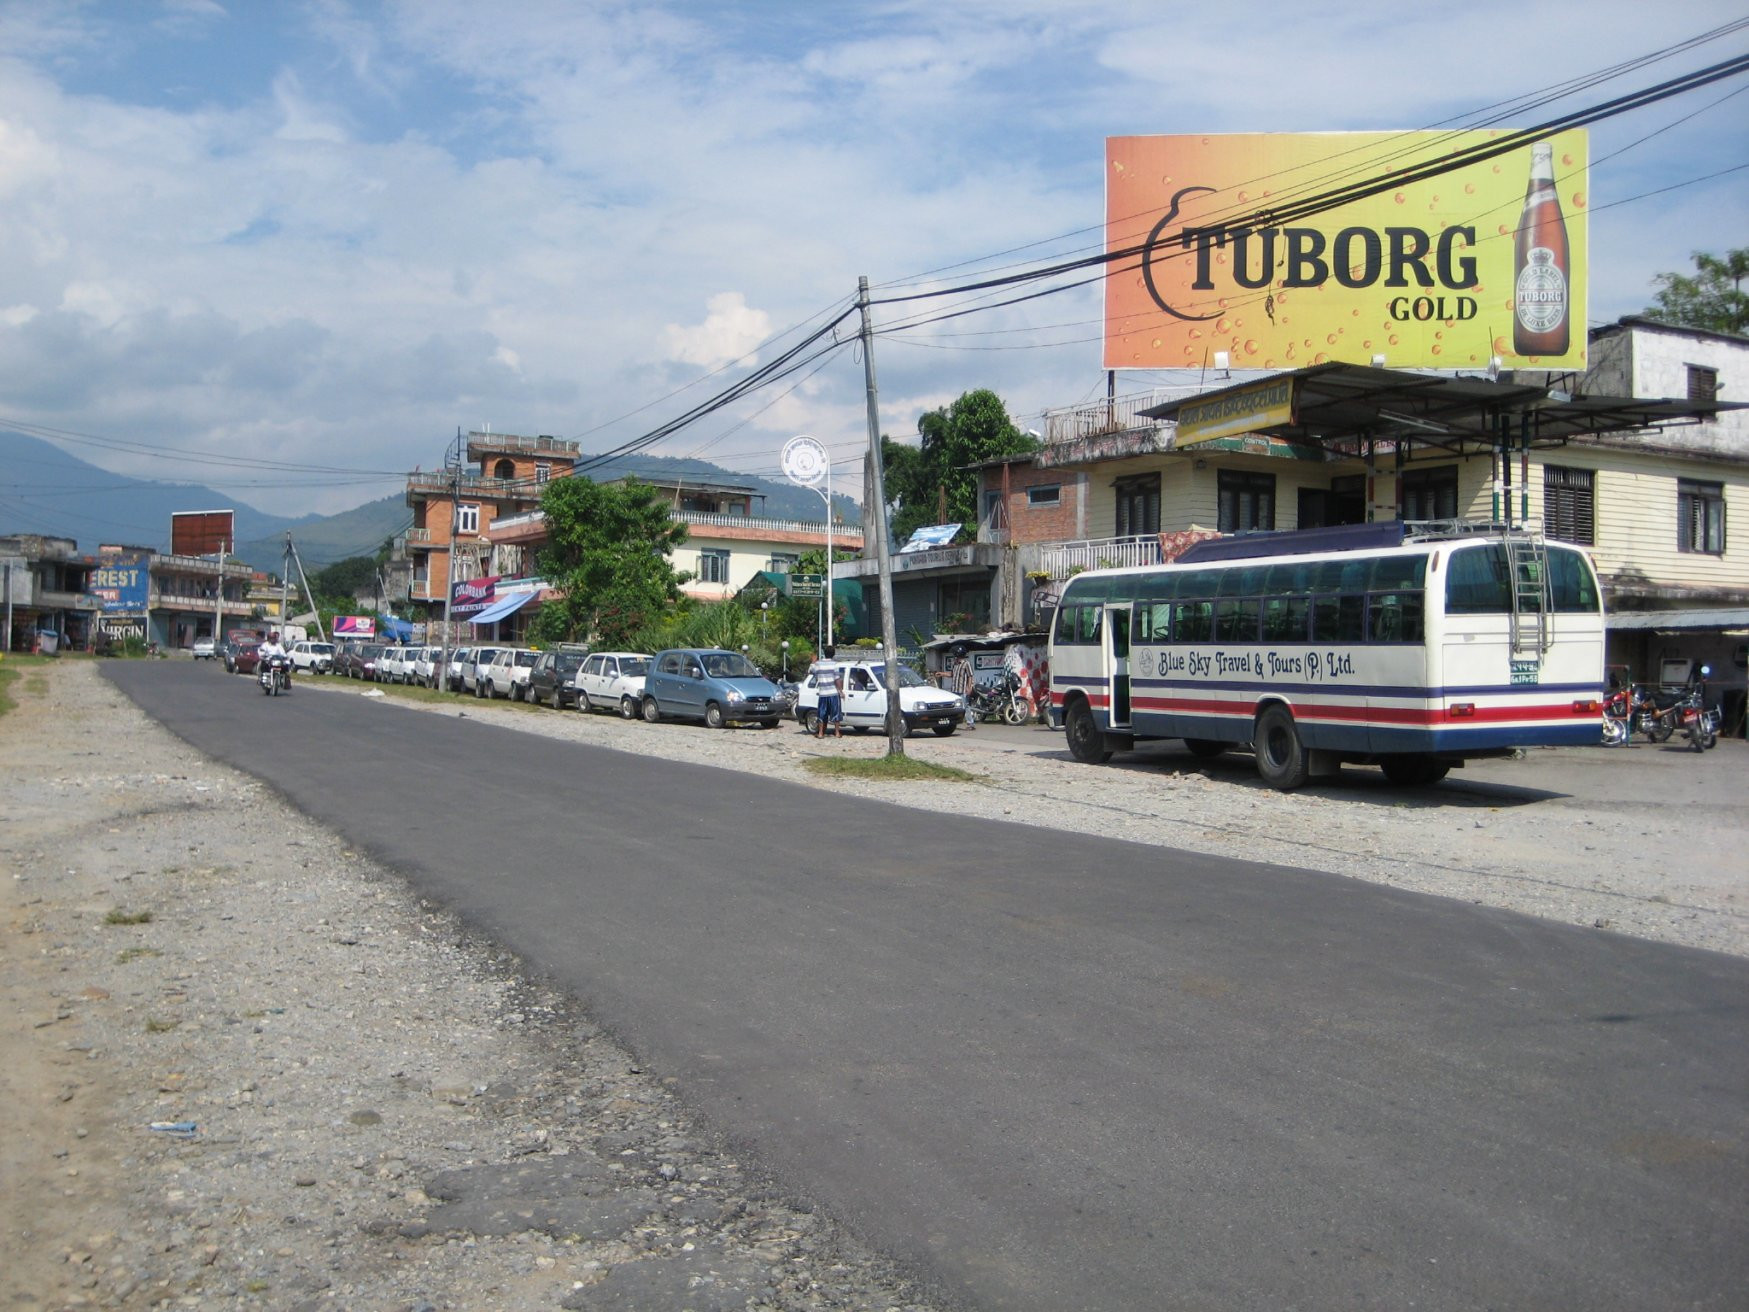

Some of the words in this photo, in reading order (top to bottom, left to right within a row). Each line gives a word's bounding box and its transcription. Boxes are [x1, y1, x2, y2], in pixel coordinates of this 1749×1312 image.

[1182, 226, 1478, 290] TUBORG
[1389, 296, 1478, 321] GOLD
[1519, 291, 1561, 302] TUBORG
[1158, 651, 1185, 677] Blue
[1188, 651, 1212, 677] Sky
[1215, 651, 1251, 676] Travel
[1255, 652, 1265, 680] &
[1268, 651, 1302, 677] Tours
[1326, 651, 1355, 677] Ltd.
